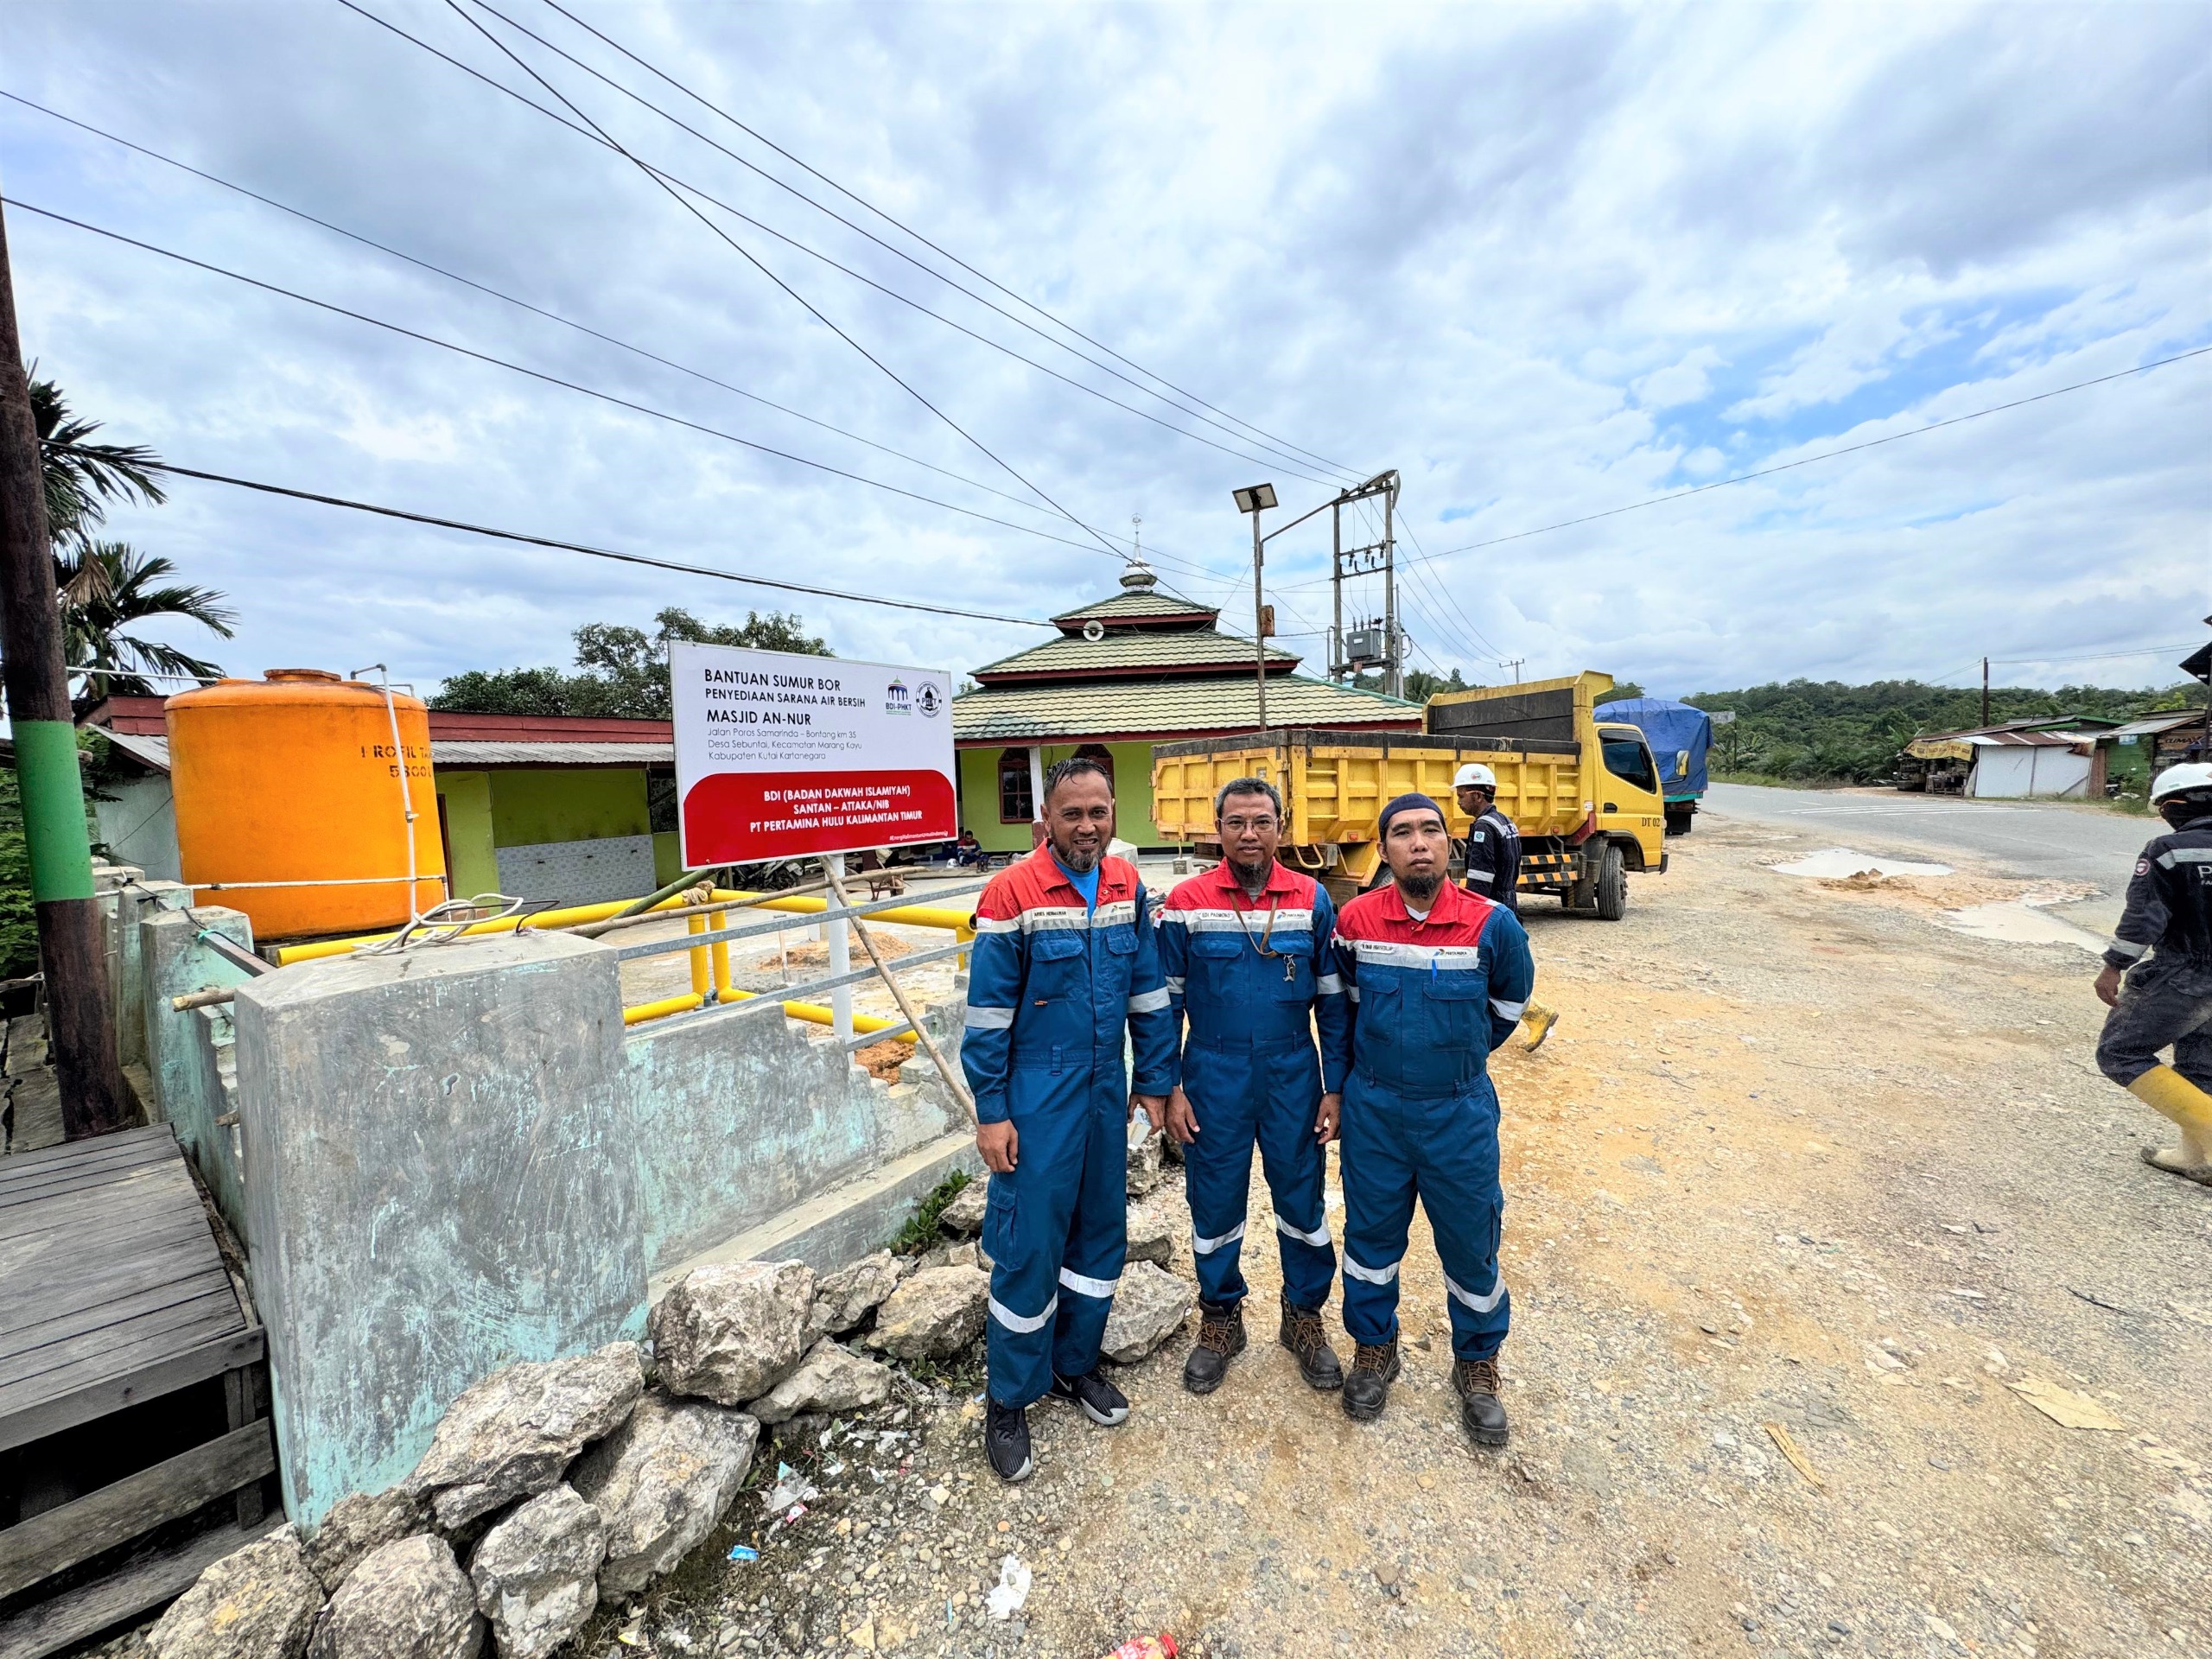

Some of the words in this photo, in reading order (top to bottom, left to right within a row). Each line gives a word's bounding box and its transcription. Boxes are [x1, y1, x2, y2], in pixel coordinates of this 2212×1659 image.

[704, 668, 768, 686] BANTUAN
[772, 675, 814, 690] SUMUR
[817, 678, 841, 691] BOR
[705, 688, 774, 702] PENYEDIAAN
[777, 692, 818, 705] SARANA
[821, 696, 836, 706] AIR
[838, 696, 866, 708] BERSIH
[885, 702, 912, 711] BDI-PHKT
[707, 709, 758, 723] MASJID
[762, 711, 811, 726] AN-NUR
[708, 728, 731, 736] Jalan
[733, 728, 755, 737] Poros
[757, 728, 798, 738] Samarinda
[806, 730, 836, 740] Bontang
[708, 739, 730, 748] Desa
[772, 741, 816, 749] Kecamatan
[817, 741, 844, 751] Marang
[709, 751, 756, 761] Kabupaten
[758, 752, 778, 760] Kutai
[779, 752, 826, 761] Kartanegara
[764, 790, 781, 802] BDI
[783, 788, 822, 803] (BADAN
[824, 787, 863, 799] DAKWAH
[865, 785, 911, 797] ISLAMIYAH)
[793, 803, 832, 815] SANTAN
[841, 799, 890, 811] ATTAKA/NIB
[750, 821, 761, 833] PT
[764, 817, 820, 832] PERTAMINA
[822, 816, 844, 828] HULU
[846, 812, 899, 825] KALIMANTAN
[899, 810, 923, 821] TIMUR
[1642, 817, 1651, 827] DT
[1652, 817, 1661, 827] 02
